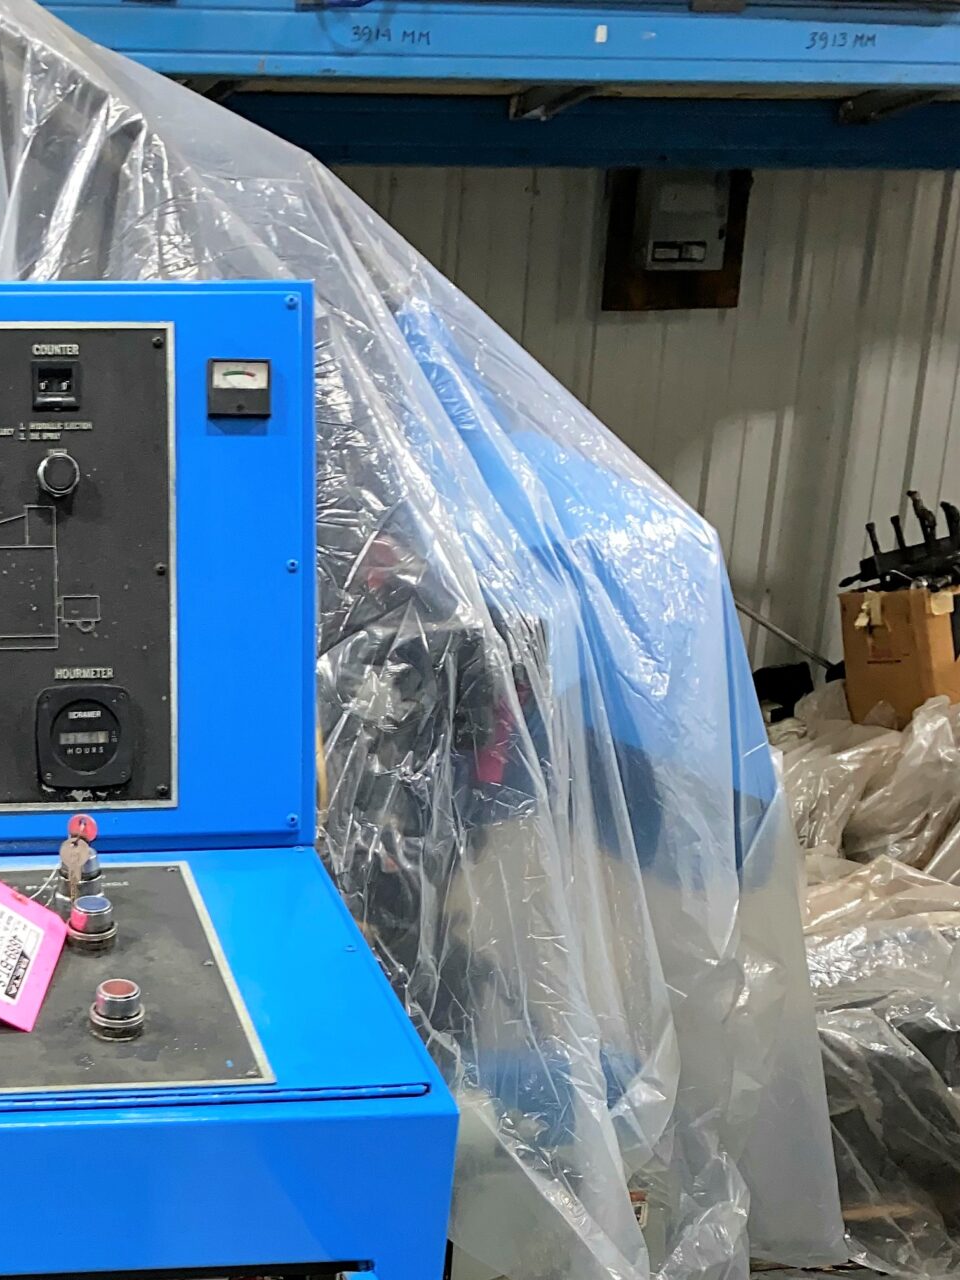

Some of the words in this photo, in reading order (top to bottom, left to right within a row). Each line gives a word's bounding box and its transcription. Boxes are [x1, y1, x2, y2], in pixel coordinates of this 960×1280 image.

[805, 31, 848, 50] 3913
[852, 33, 877, 49] MM
[32, 344, 80, 356] COUNTER
[54, 667, 114, 679] HOURMETER
[67, 746, 104, 755] HOURS
